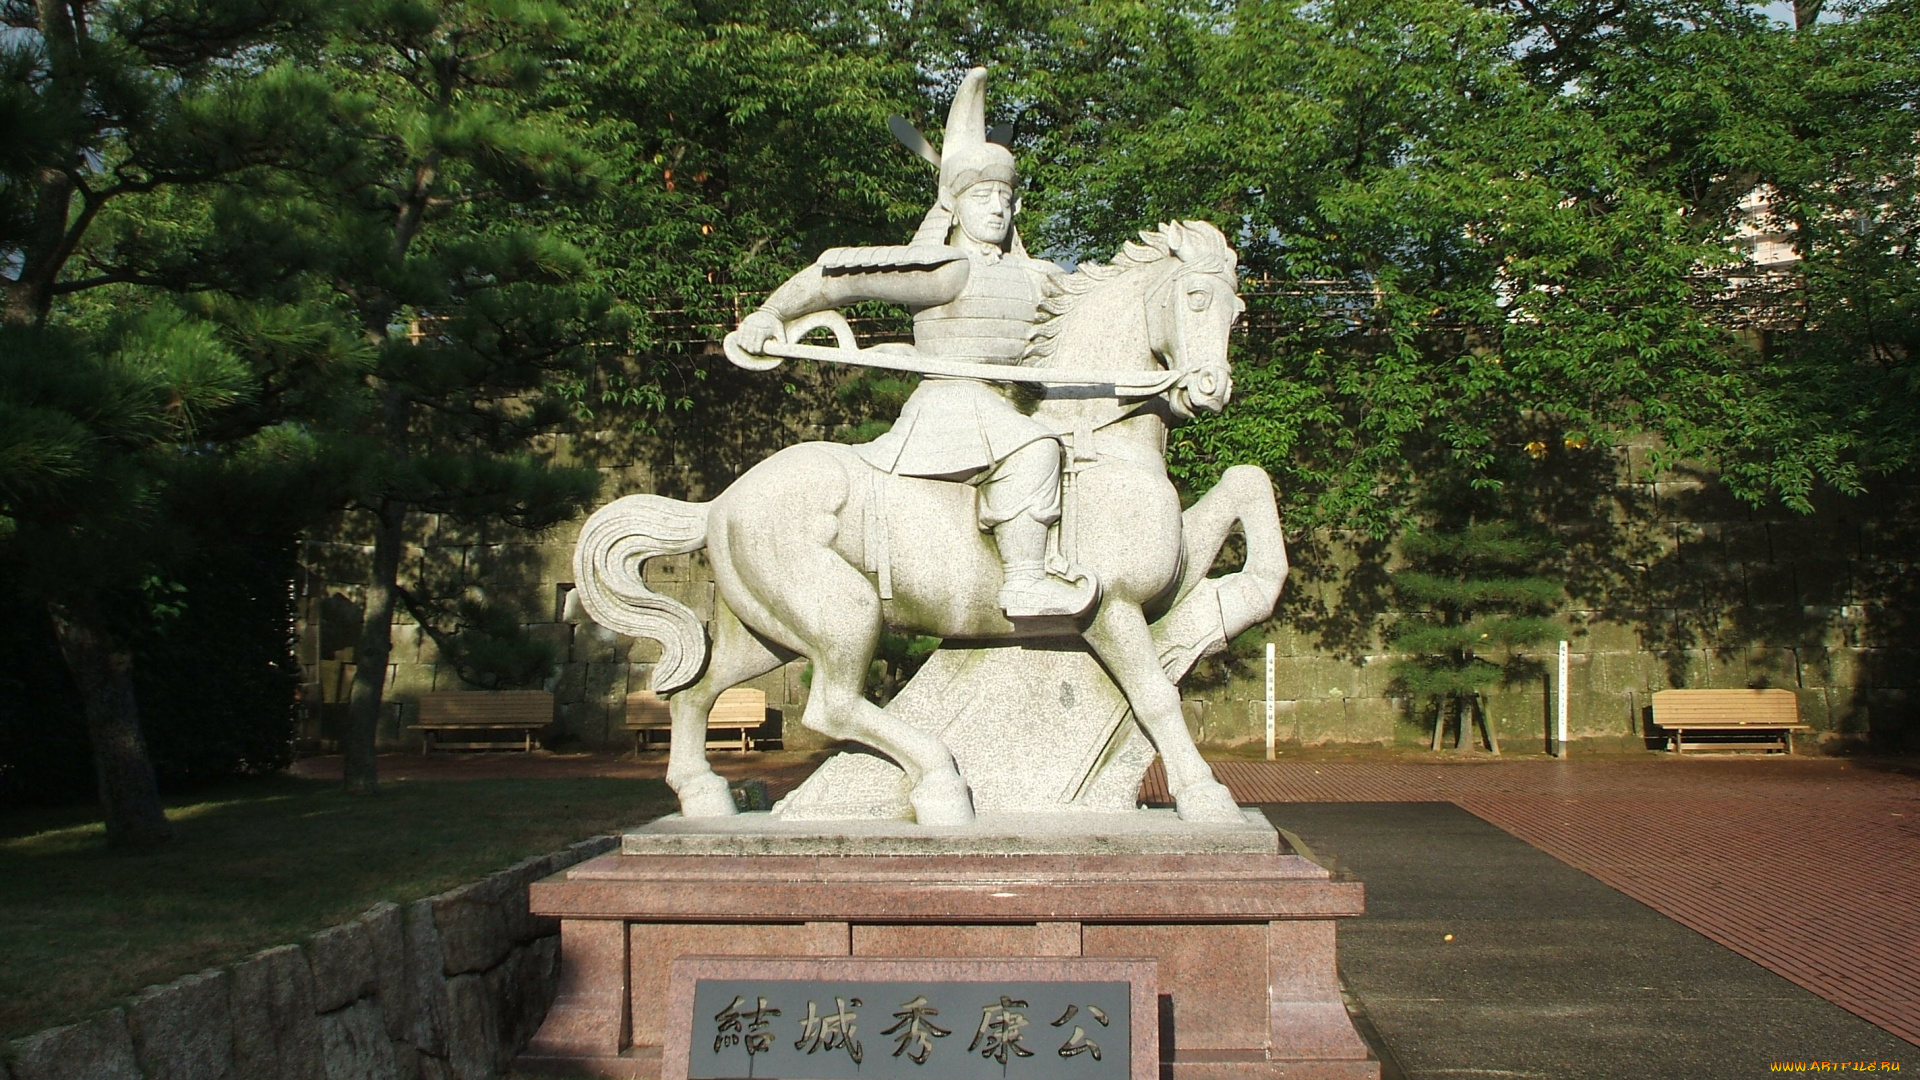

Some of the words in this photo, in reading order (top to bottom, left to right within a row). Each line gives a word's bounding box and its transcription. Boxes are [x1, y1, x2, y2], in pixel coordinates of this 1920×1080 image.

[714, 995, 1110, 1065] 結城秀康公
